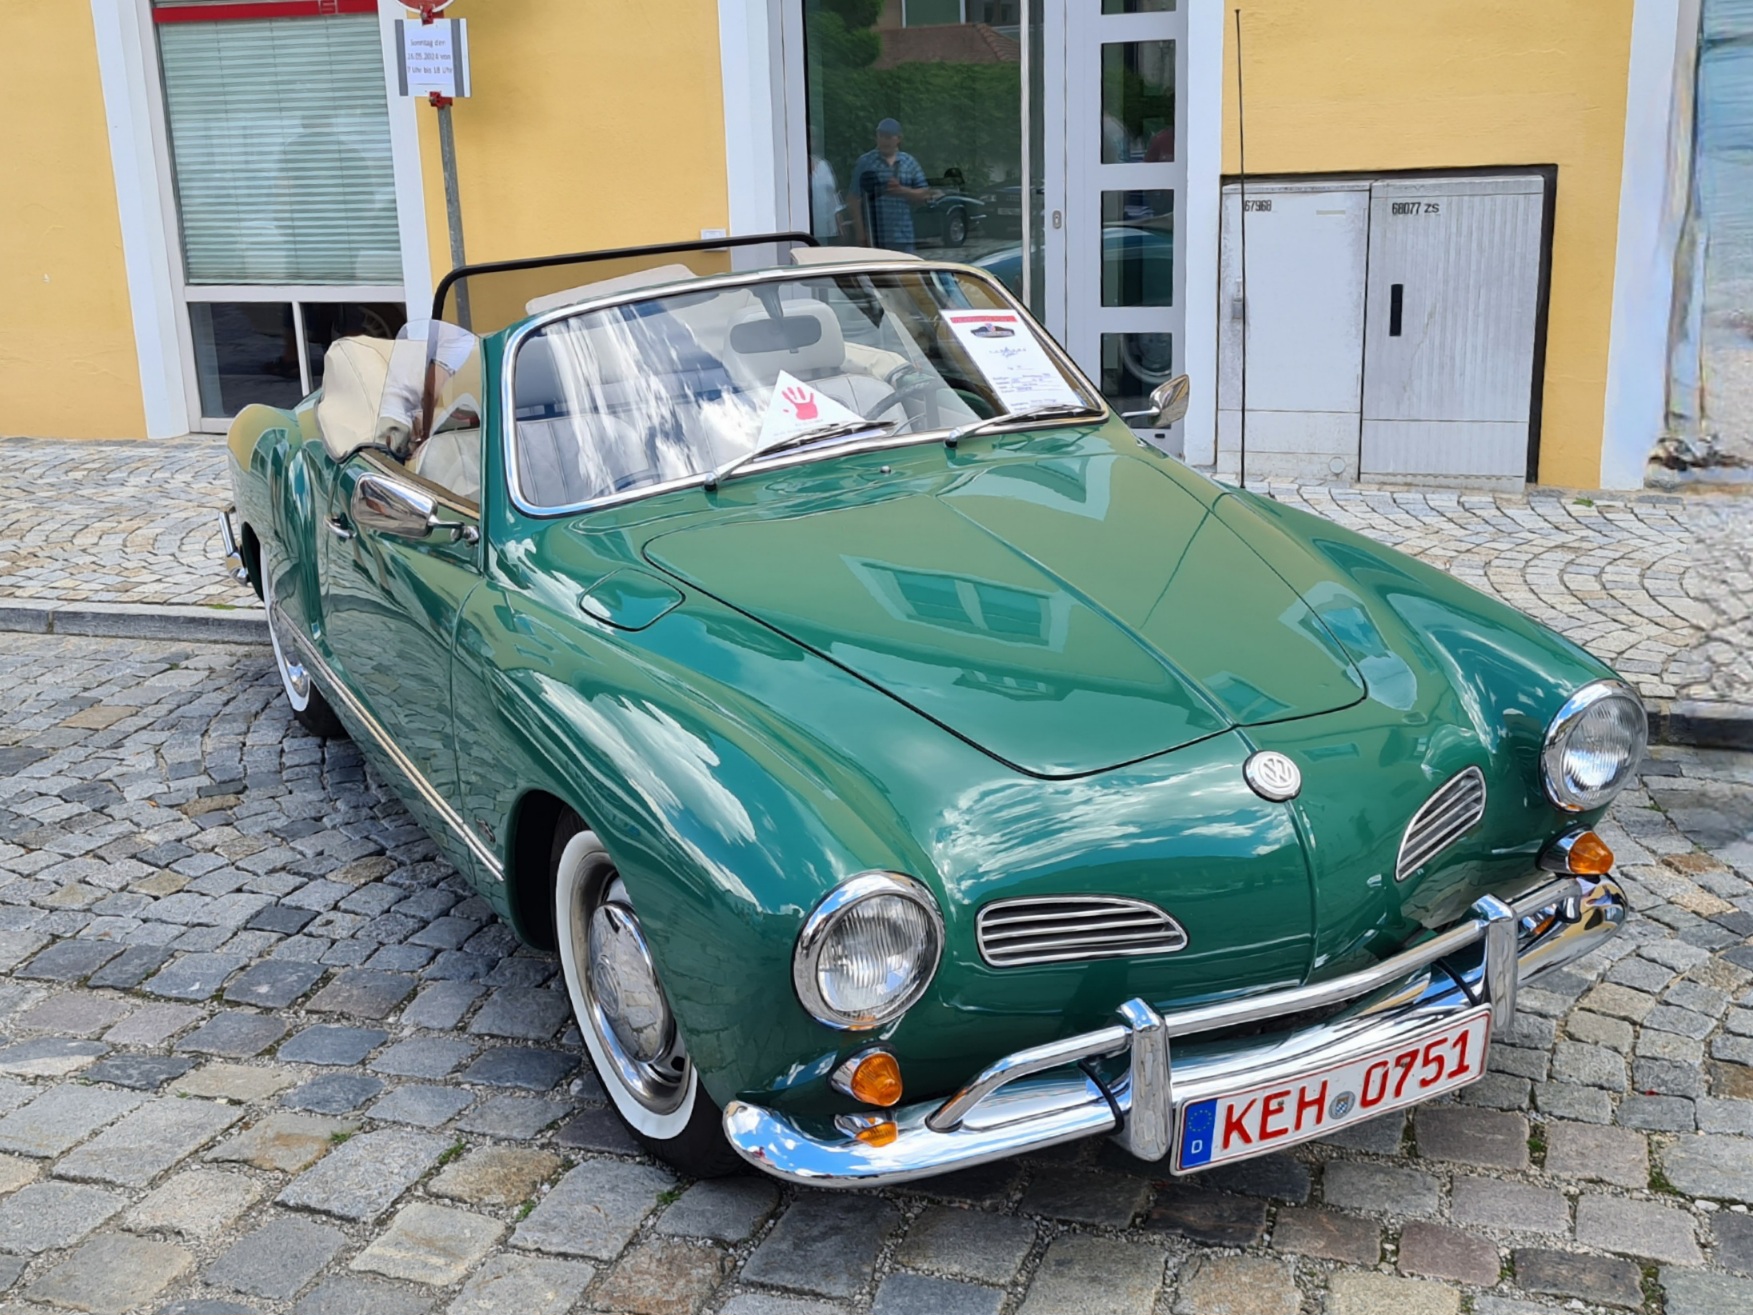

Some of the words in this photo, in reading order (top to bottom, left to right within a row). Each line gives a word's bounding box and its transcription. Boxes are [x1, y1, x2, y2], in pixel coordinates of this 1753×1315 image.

[423, 66, 432, 74] bis
[1392, 201, 1421, 215] 68077
[1221, 1079, 1328, 1150] KEH
[1359, 1029, 1471, 1109] 0751
[1191, 1139, 1203, 1153] D
